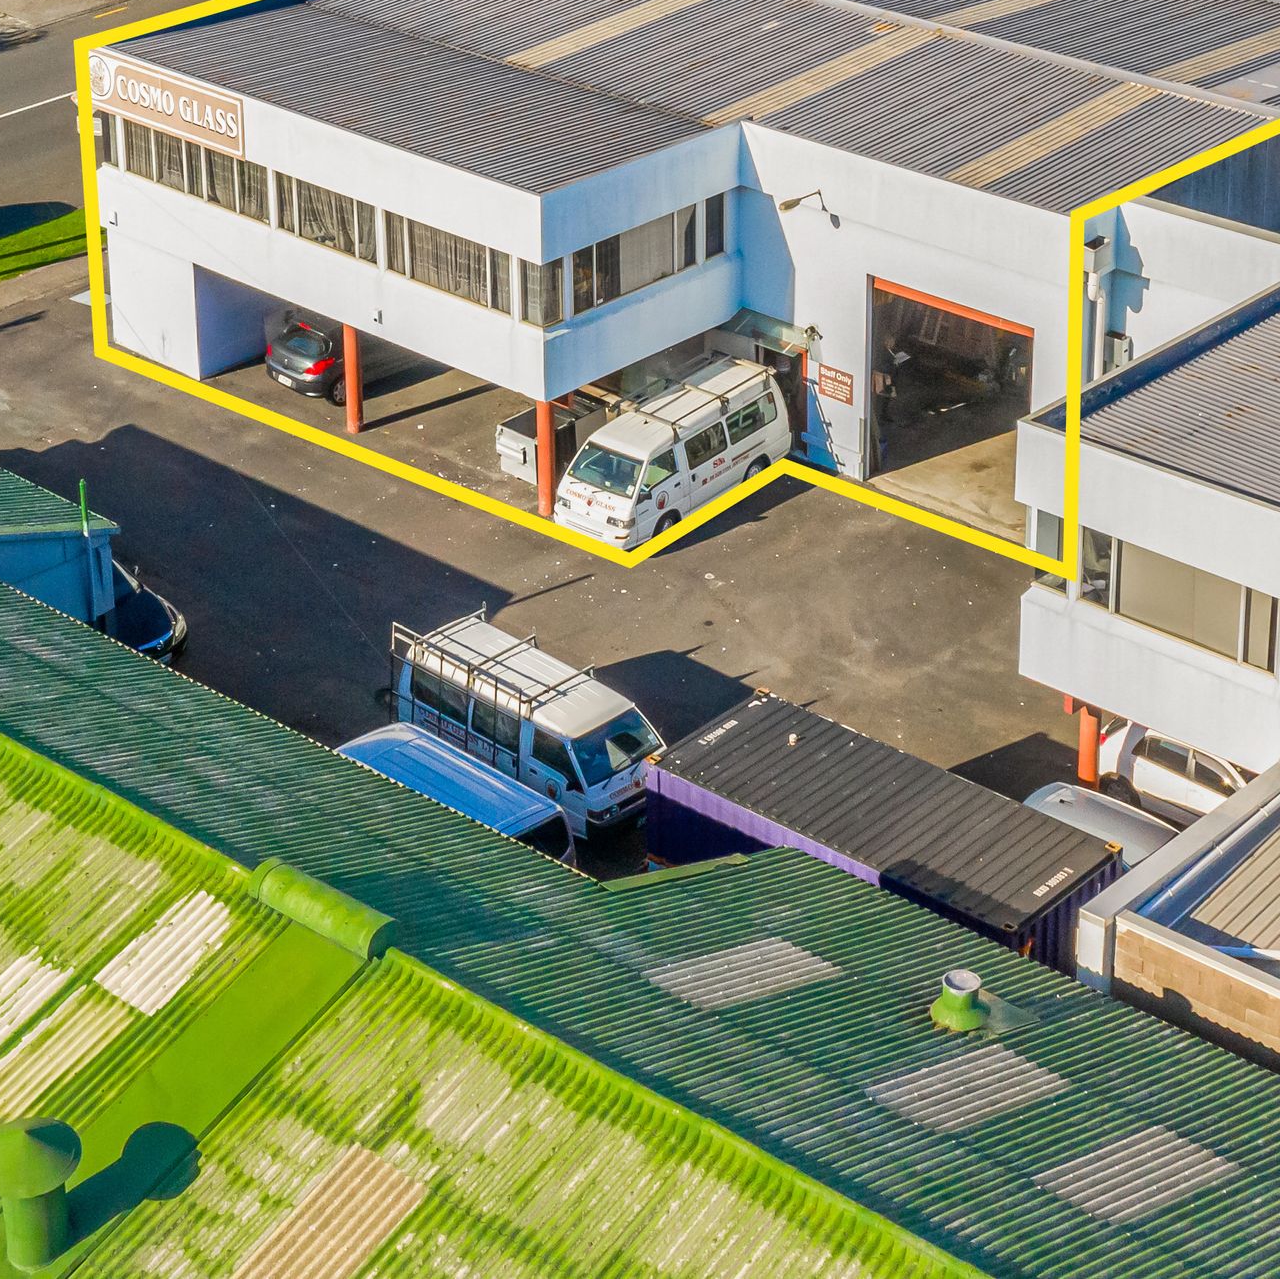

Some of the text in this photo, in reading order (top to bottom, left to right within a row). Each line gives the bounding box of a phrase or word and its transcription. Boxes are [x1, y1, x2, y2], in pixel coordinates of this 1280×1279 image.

[116, 75, 238, 139] COSMO GLASS
[820, 366, 852, 386] Staff Only
[566, 488, 616, 512] COSMO GLASS
